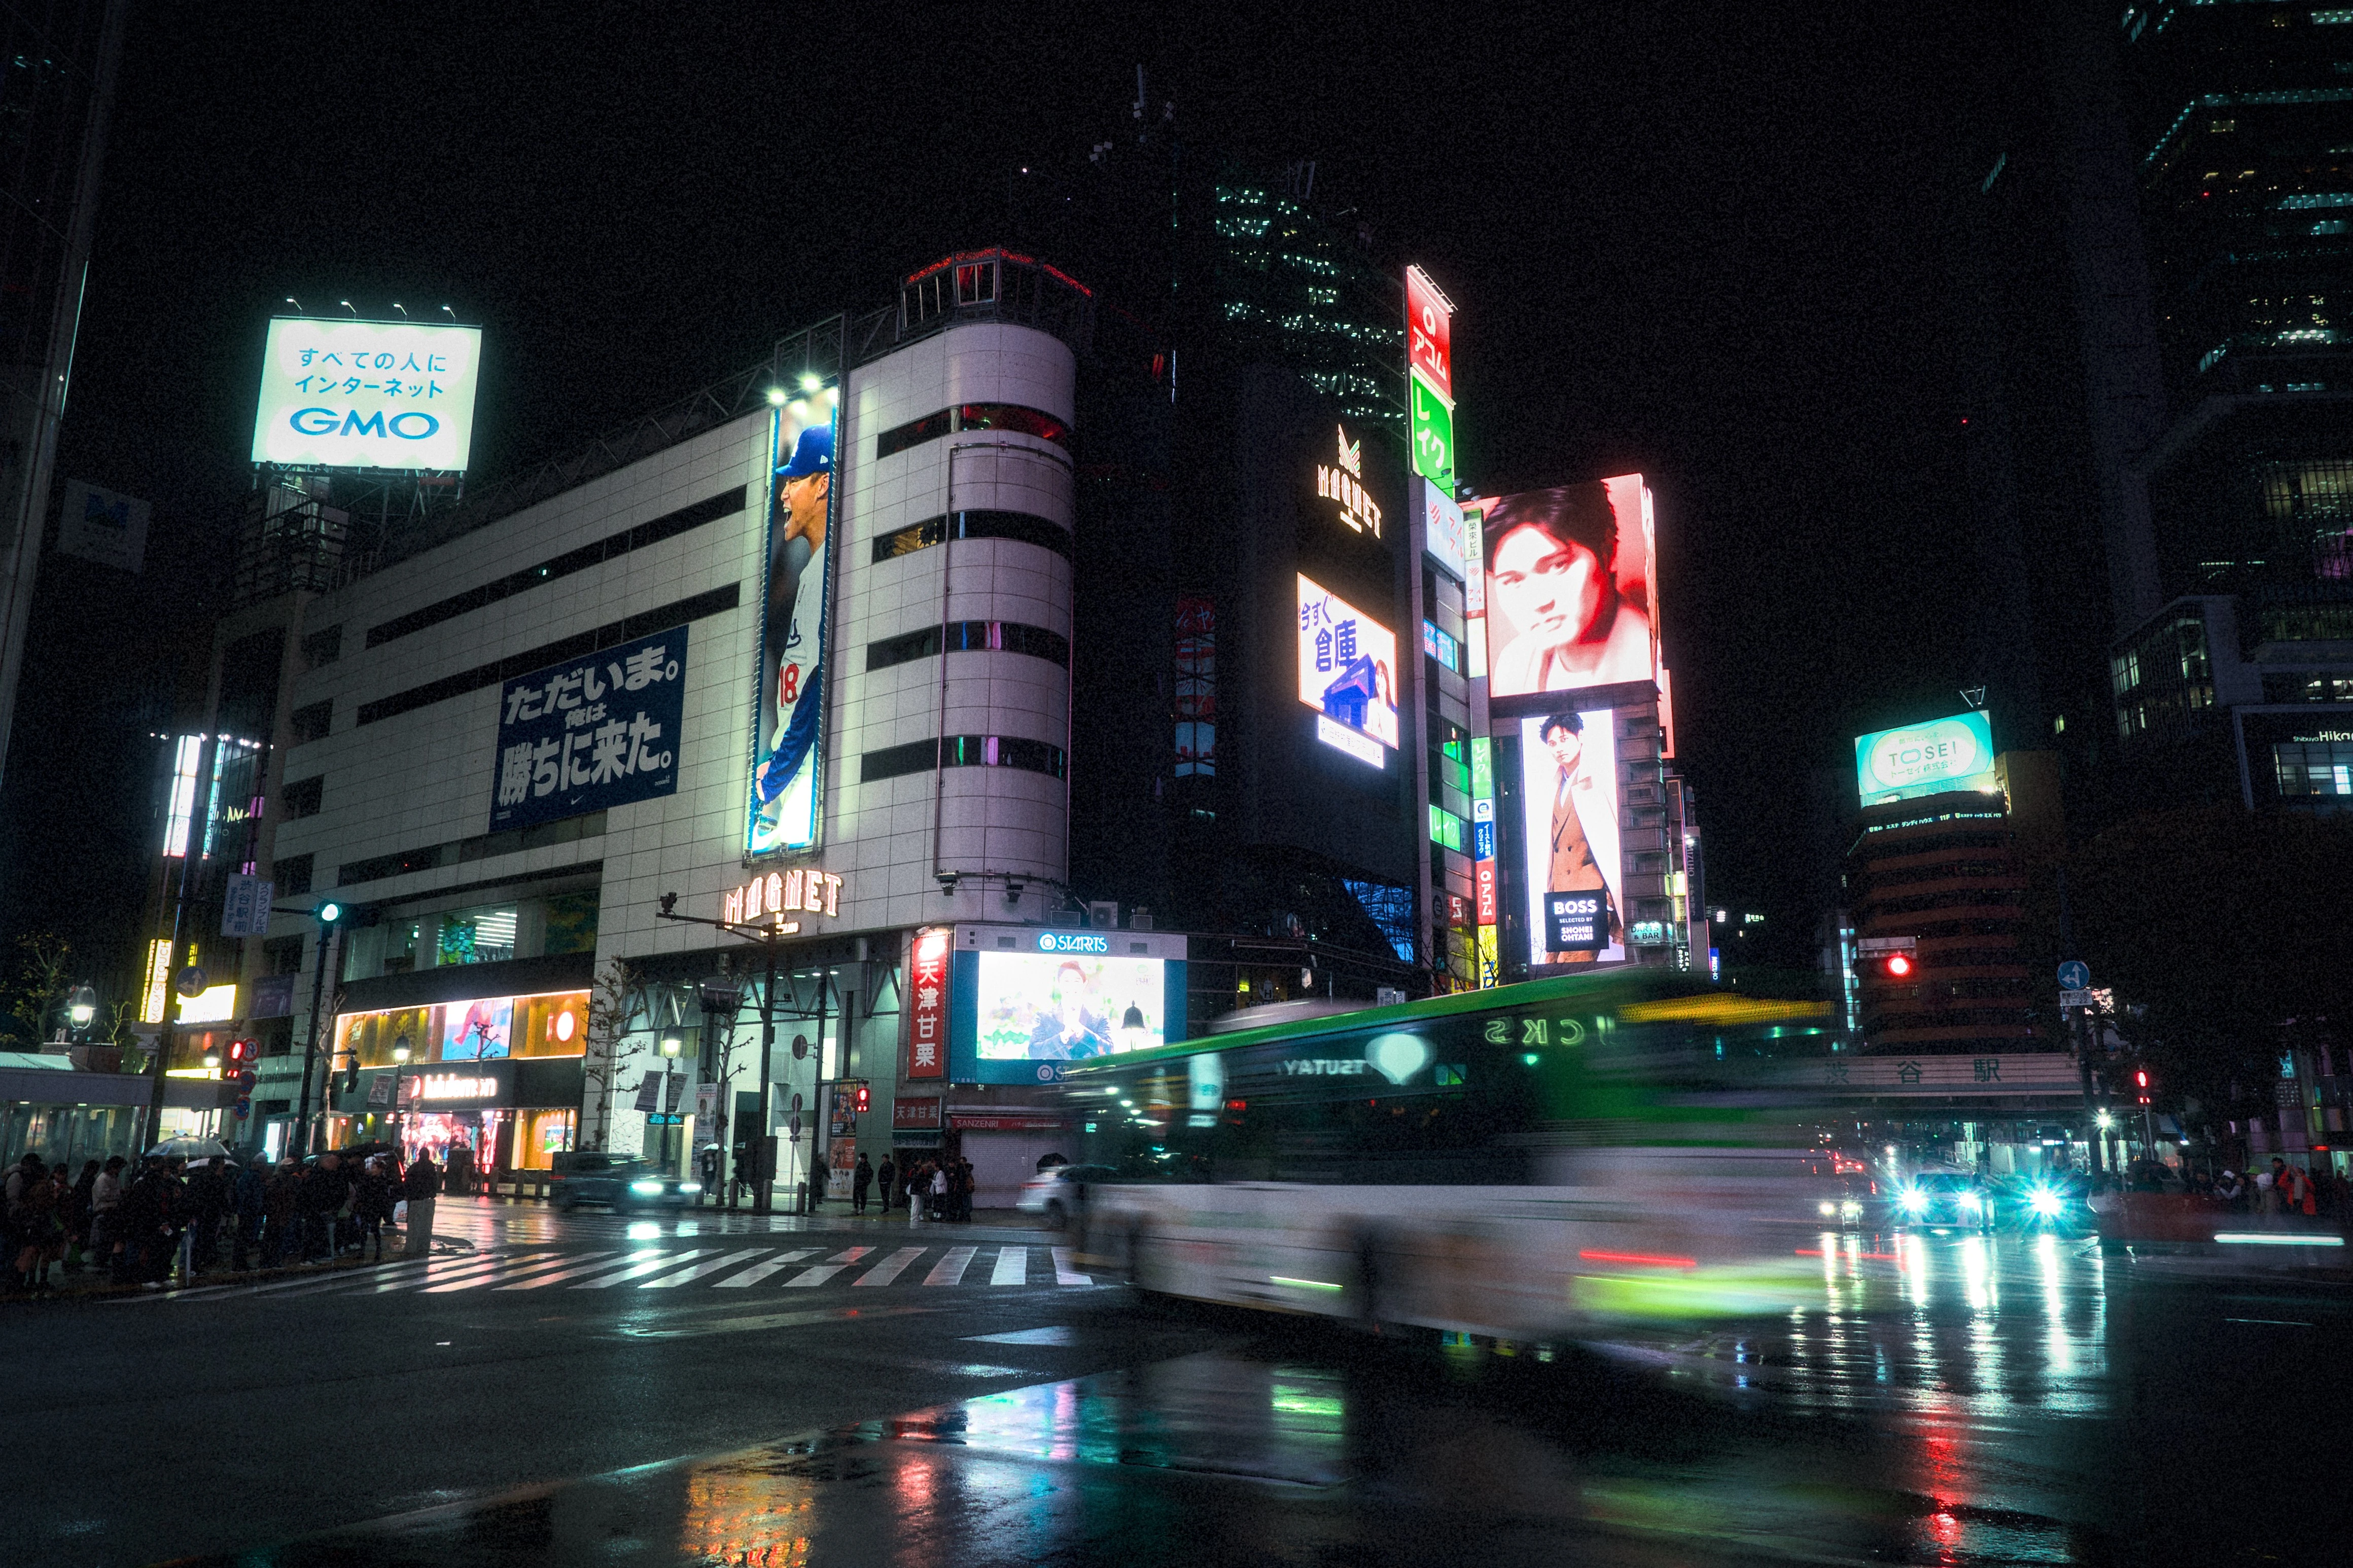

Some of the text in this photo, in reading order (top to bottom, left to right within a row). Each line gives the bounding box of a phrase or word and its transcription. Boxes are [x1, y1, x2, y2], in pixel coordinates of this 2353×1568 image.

[299, 348, 447, 372] すべての人に
[1413, 325, 1447, 381] アコム
[295, 375, 443, 399] インターネット
[290, 407, 440, 440] GMO
[1416, 385, 1445, 469] レイク
[1318, 464, 1382, 539] MAGNET
[1301, 592, 1333, 631] 今すぐ
[1315, 619, 1359, 672] 倉庫
[505, 645, 679, 725] ただいま。
[780, 662, 799, 708] 18
[565, 702, 607, 730] 俺は
[2319, 731, 2353, 742] Hika
[498, 711, 672, 807] 勝ちに来た。
[1476, 744, 1486, 773] レイク
[1888, 741, 1957, 767] TOSEI
[1434, 814, 1457, 838] レイク
[724, 869, 842, 929] MAGNET
[1481, 883, 1493, 916] アコム
[1554, 899, 1597, 914] BOSS
[1561, 925, 1593, 934] SHOHEI
[1561, 933, 1593, 942] OHTANI
[1631, 924, 1659, 933] DARTS
[1642, 932, 1660, 940] BAR
[1057, 935, 1108, 952] STARTS
[156, 940, 170, 981] TOUCH
[151, 984, 163, 1021] MOM'S
[915, 960, 939, 1067] 天津甘栗
[896, 1106, 937, 1119] 天津甘栗
[957, 1120, 999, 1128] SANZENRI
